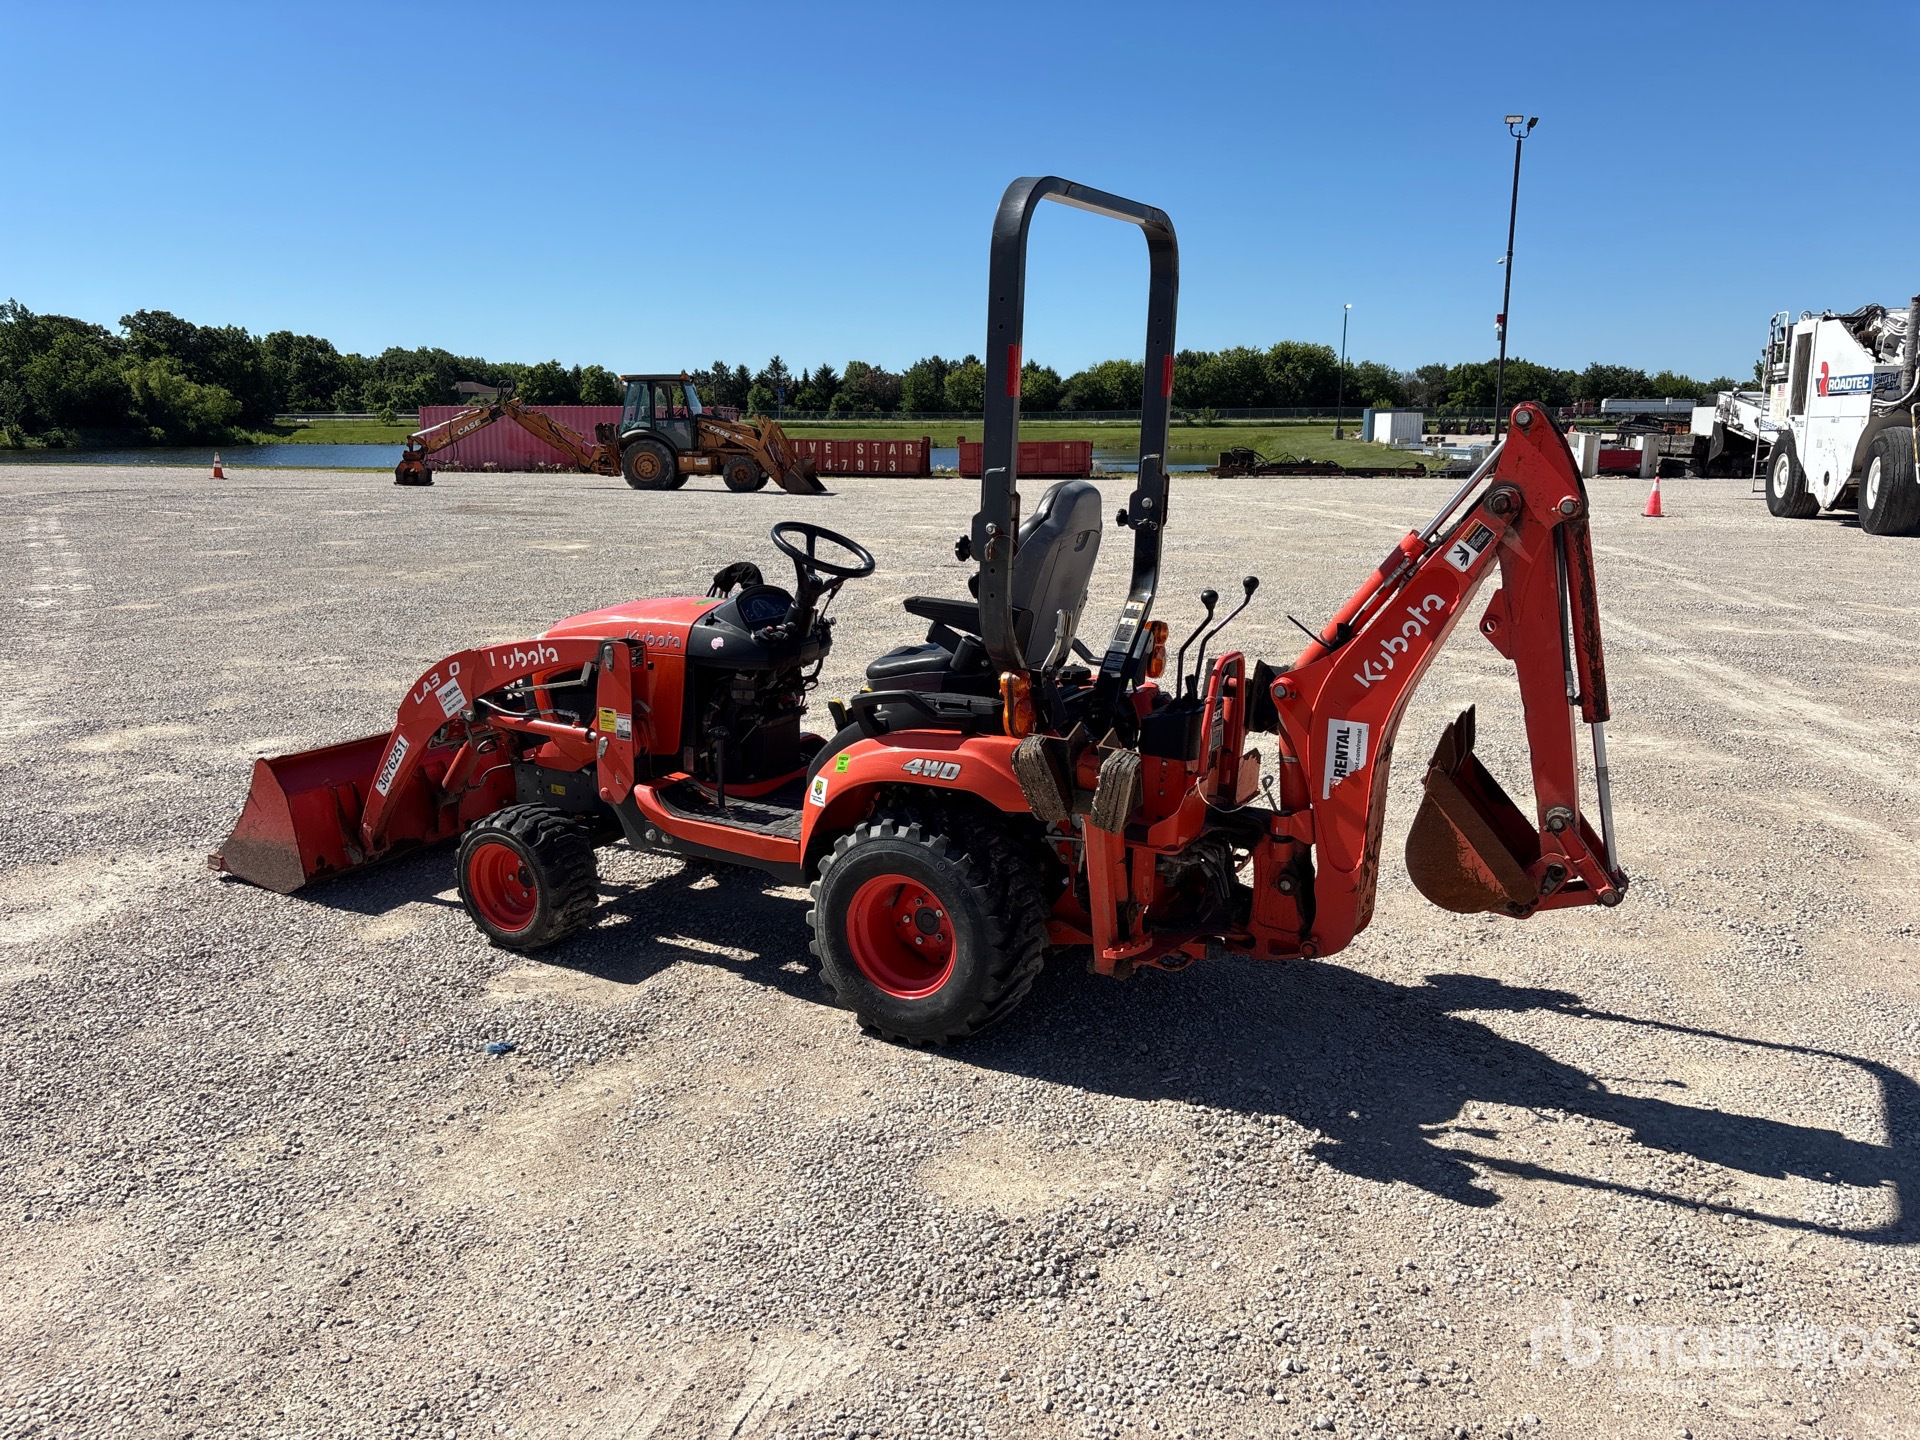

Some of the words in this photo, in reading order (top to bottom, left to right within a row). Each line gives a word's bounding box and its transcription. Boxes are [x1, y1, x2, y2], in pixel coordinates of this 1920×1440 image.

[1828, 375, 1870, 391] ROADTEC
[457, 419, 482, 436] CASE
[709, 425, 731, 438] CASE
[794, 442, 832, 454] IVE
[856, 443, 913, 456] STAR
[793, 459, 896, 472] 4-7973
[1353, 594, 1446, 688] Kubota
[413, 661, 460, 705] LA30
[1334, 727, 1350, 778] RENTAL
[901, 757, 962, 781] 4WD
